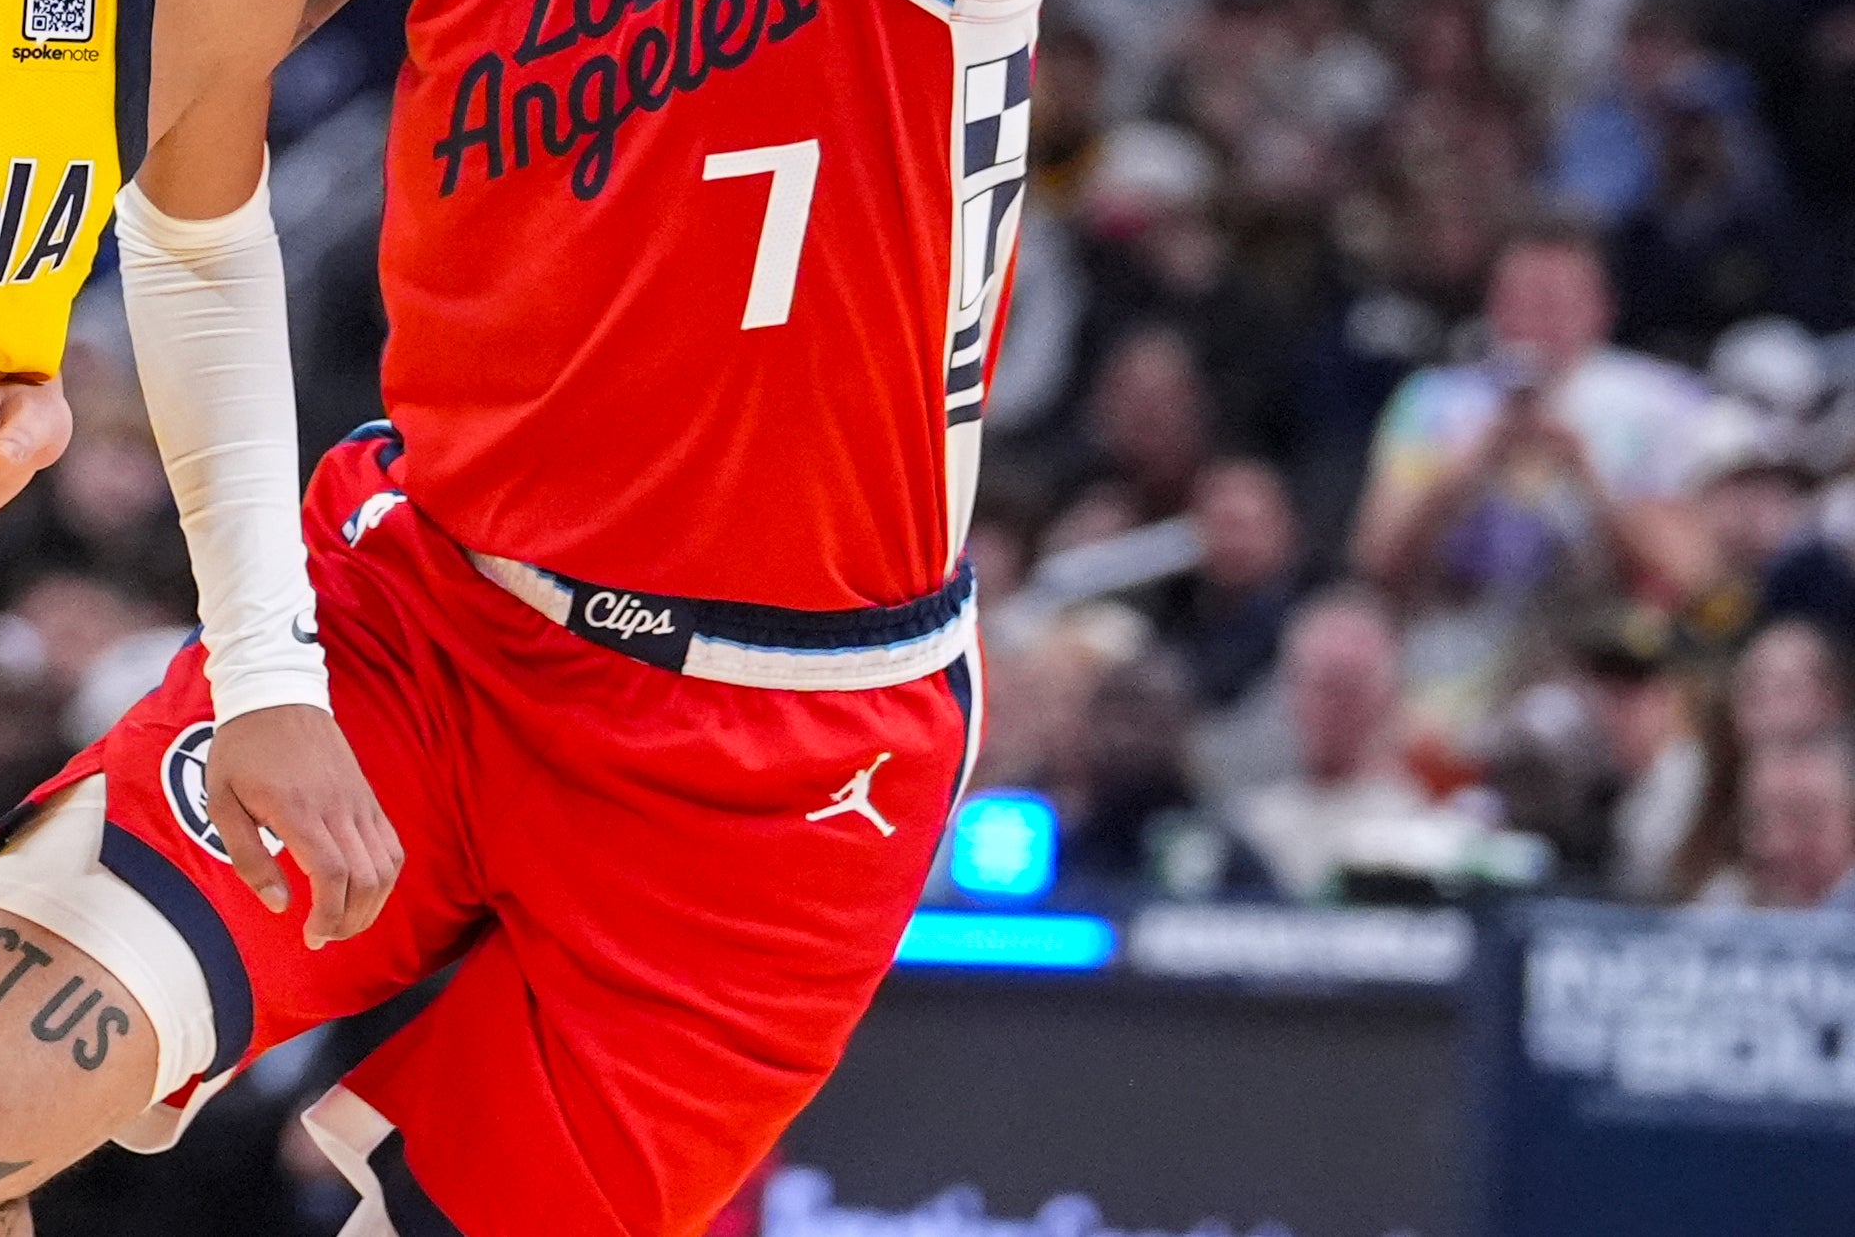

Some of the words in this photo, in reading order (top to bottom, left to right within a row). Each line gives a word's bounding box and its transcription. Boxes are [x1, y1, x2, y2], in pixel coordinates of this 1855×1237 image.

[11, 44, 100, 63] spokenote
[702, 138, 821, 330] 7
[584, 591, 676, 640] Clips
[30, 975, 130, 1071] US
